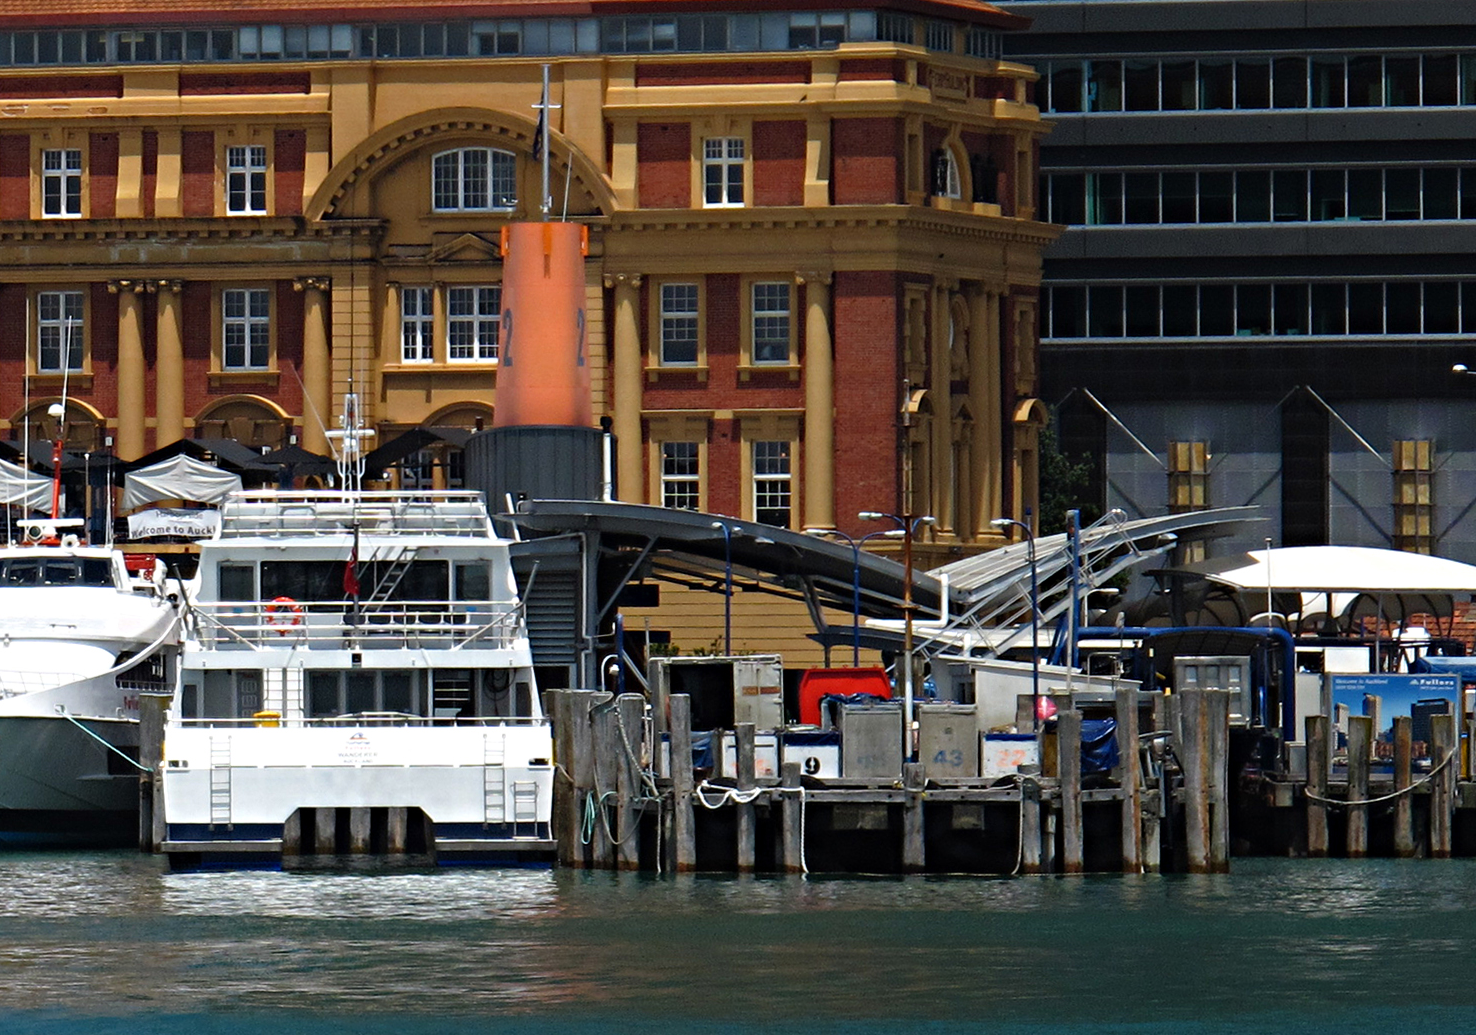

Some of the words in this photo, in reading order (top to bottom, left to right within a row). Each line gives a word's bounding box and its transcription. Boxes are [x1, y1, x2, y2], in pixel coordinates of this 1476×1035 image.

[503, 308, 512, 367] 2
[577, 308, 585, 367] 2
[131, 525, 171, 538] Welcome
[174, 526, 184, 534] to
[805, 756, 821, 775] 9
[933, 750, 963, 767] 43
[996, 750, 1026, 767] 22
